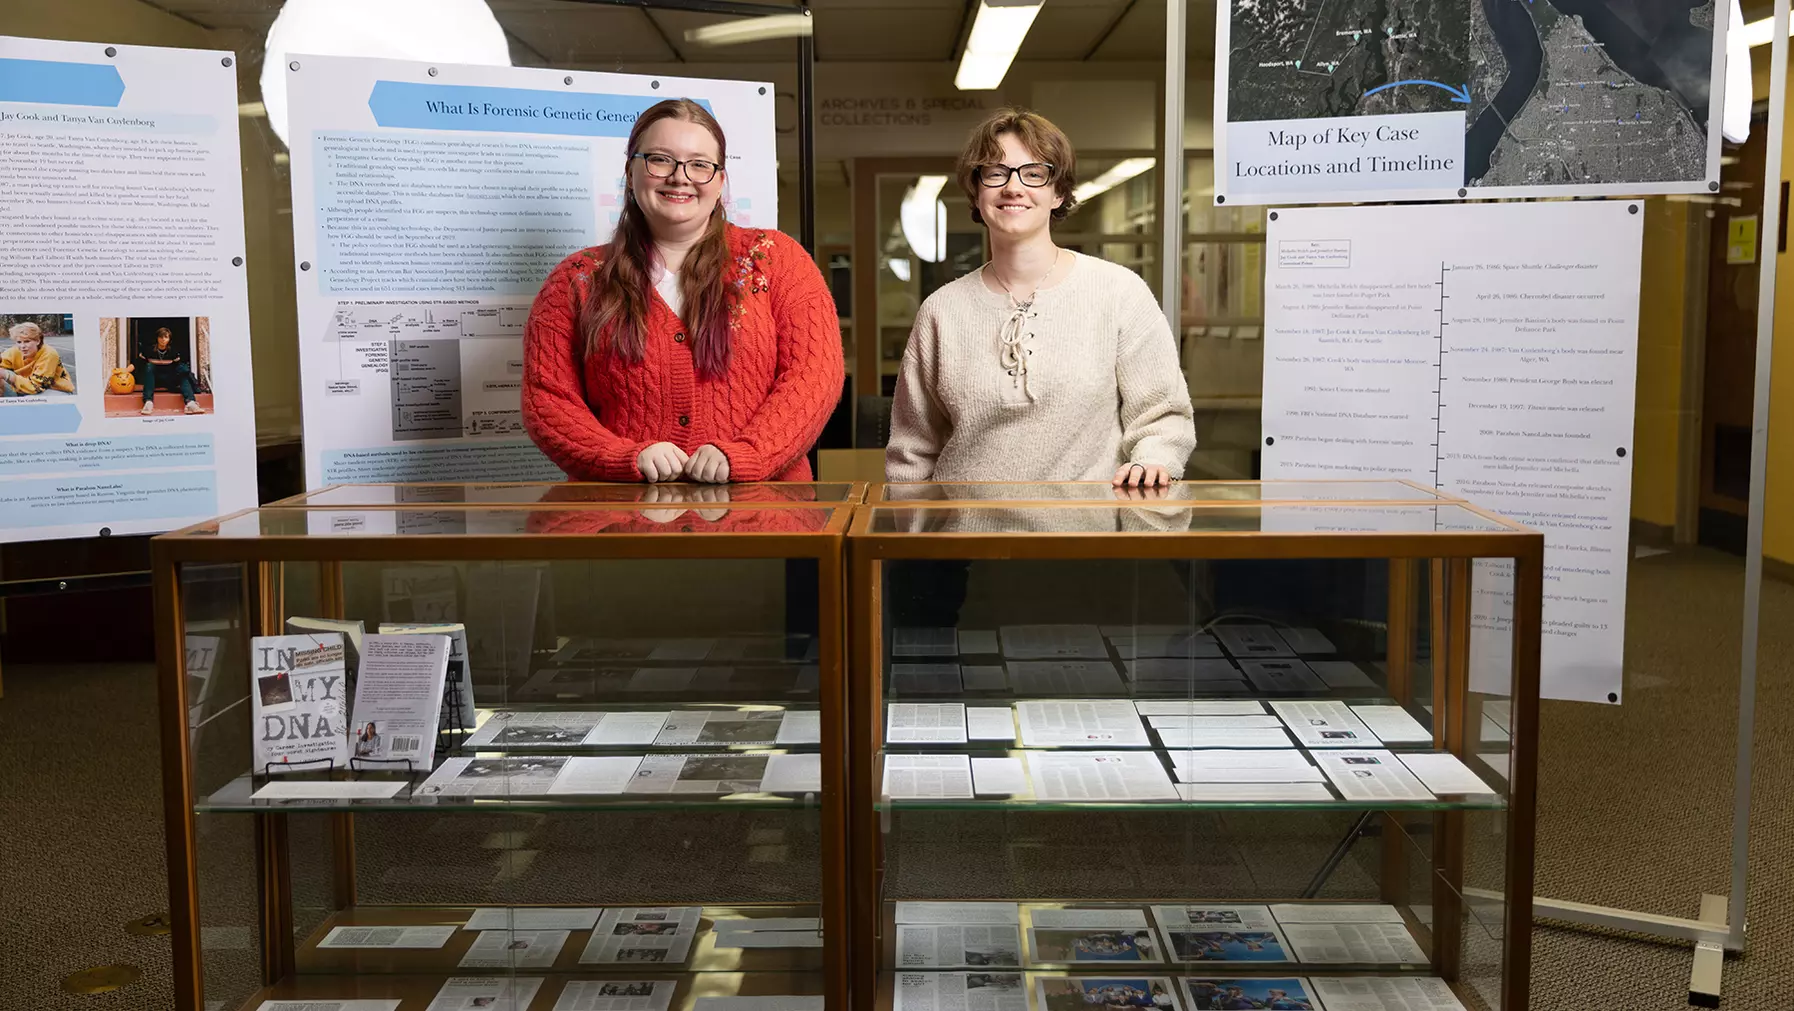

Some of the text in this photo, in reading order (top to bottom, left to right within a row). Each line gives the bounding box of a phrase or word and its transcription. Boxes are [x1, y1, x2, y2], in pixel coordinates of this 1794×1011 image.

[426, 100, 640, 122] What Is Forensic Genetic Geneal
[820, 99, 900, 110] ARCHIVES
[922, 99, 984, 110] SPECIAL
[0, 112, 155, 127] Jay Cook and Tanya Van Cuylenborg
[820, 113, 931, 126] COLLECTIONS
[1269, 125, 1419, 150] Map of Key Case
[1235, 155, 1454, 178] Locations and Timeline
[258, 647, 297, 671] IN
[295, 676, 340, 702] MY
[262, 713, 335, 741] DNA
